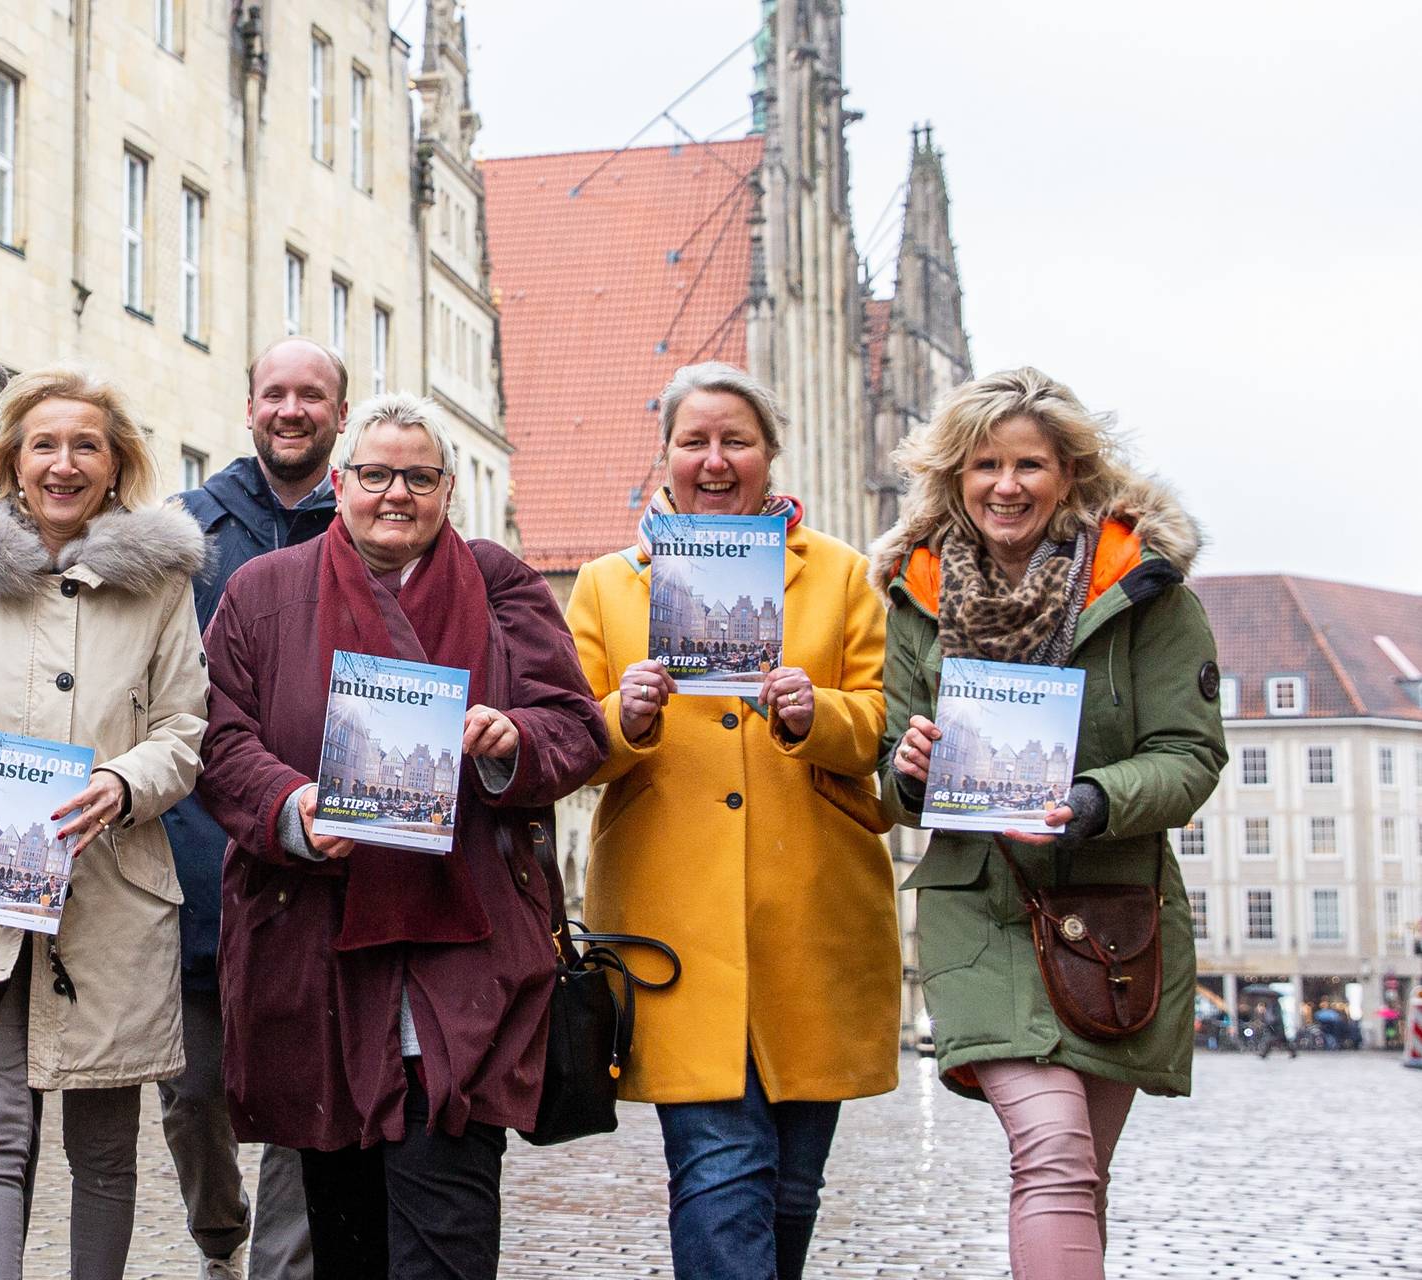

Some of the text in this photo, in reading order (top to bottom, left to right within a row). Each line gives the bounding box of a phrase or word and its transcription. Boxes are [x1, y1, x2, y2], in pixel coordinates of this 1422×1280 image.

[651, 537, 750, 558] münster
[695, 530, 780, 546] EXPLORE
[672, 656, 708, 667] TIPPS
[331, 678, 433, 706] münster
[377, 673, 464, 699] EXPLORE
[939, 681, 1046, 705] münster
[987, 676, 1078, 697] EXPLORE
[1, 749, 86, 778] EXPLORE
[325, 796, 379, 812] 66 TIPPS
[933, 790, 990, 804] 66 TIPPS
[323, 807, 349, 816] explore
[358, 811, 378, 820] enjoy
